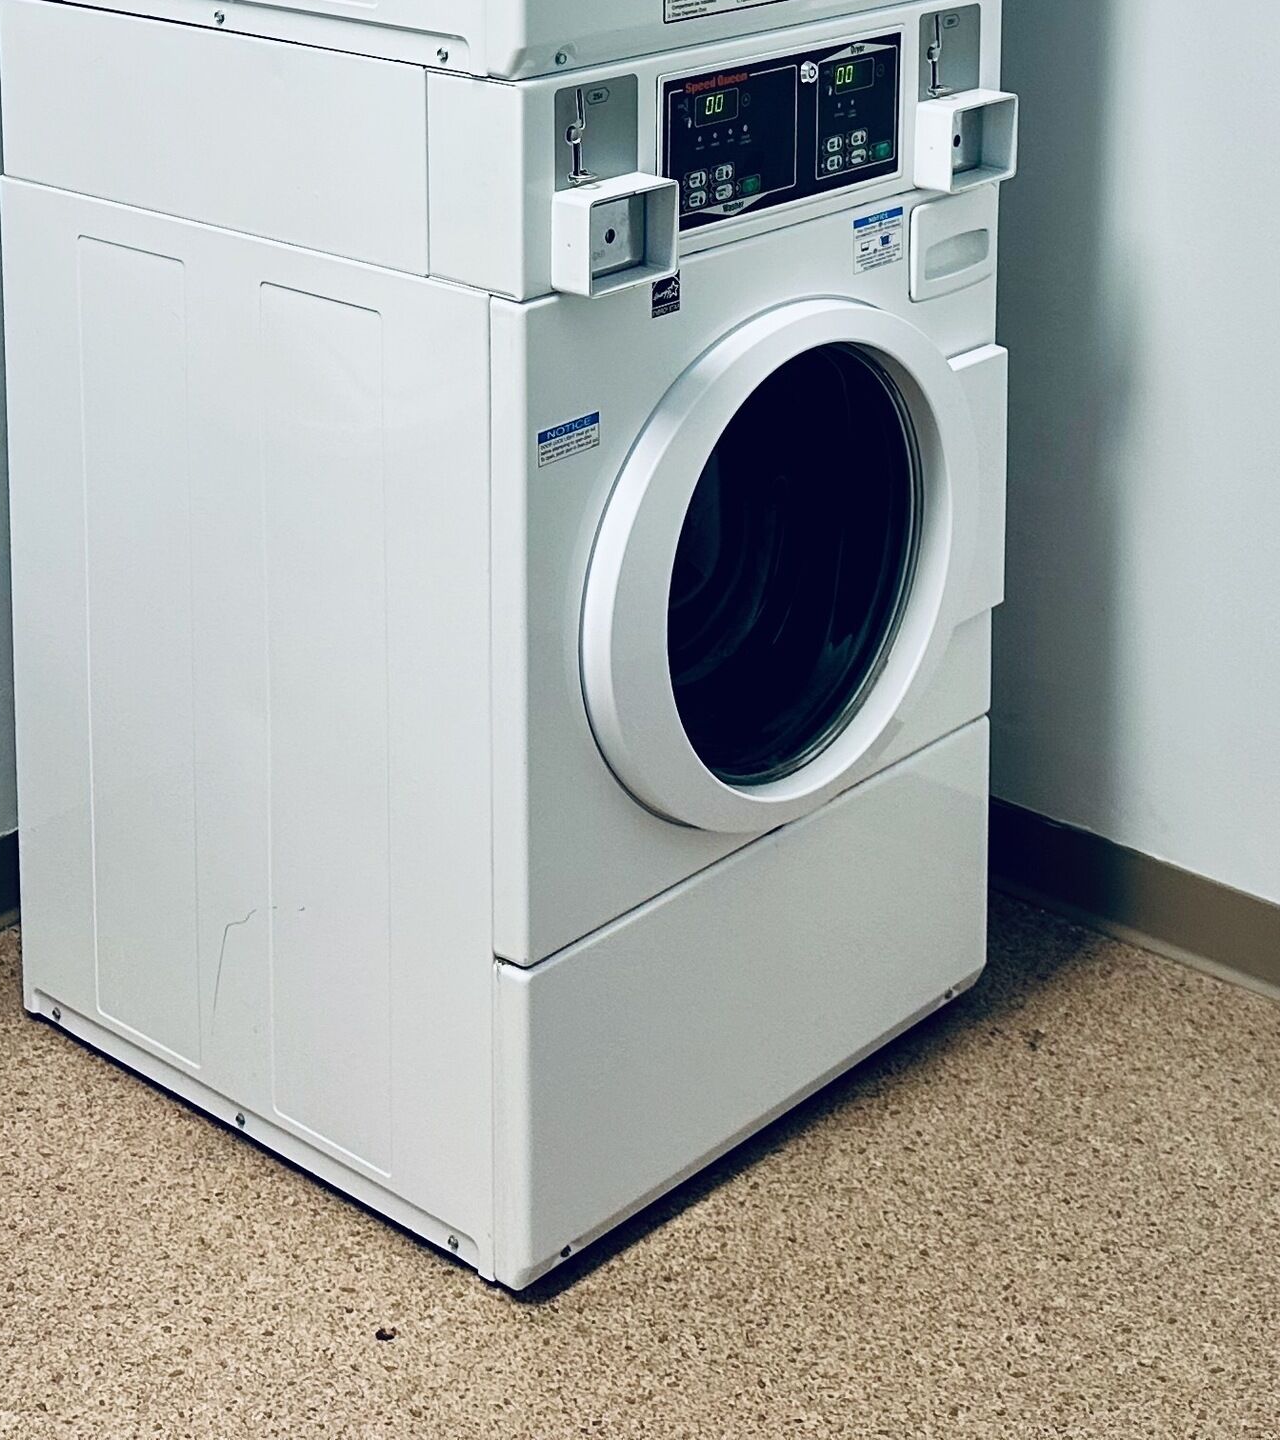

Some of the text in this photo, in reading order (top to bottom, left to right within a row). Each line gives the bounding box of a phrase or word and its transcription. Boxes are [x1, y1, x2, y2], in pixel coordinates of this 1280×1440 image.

[685, 72, 748, 95] Speed Queen
[836, 65, 853, 85] 00
[705, 94, 724, 115] 00
[546, 415, 593, 440] NOTICE
